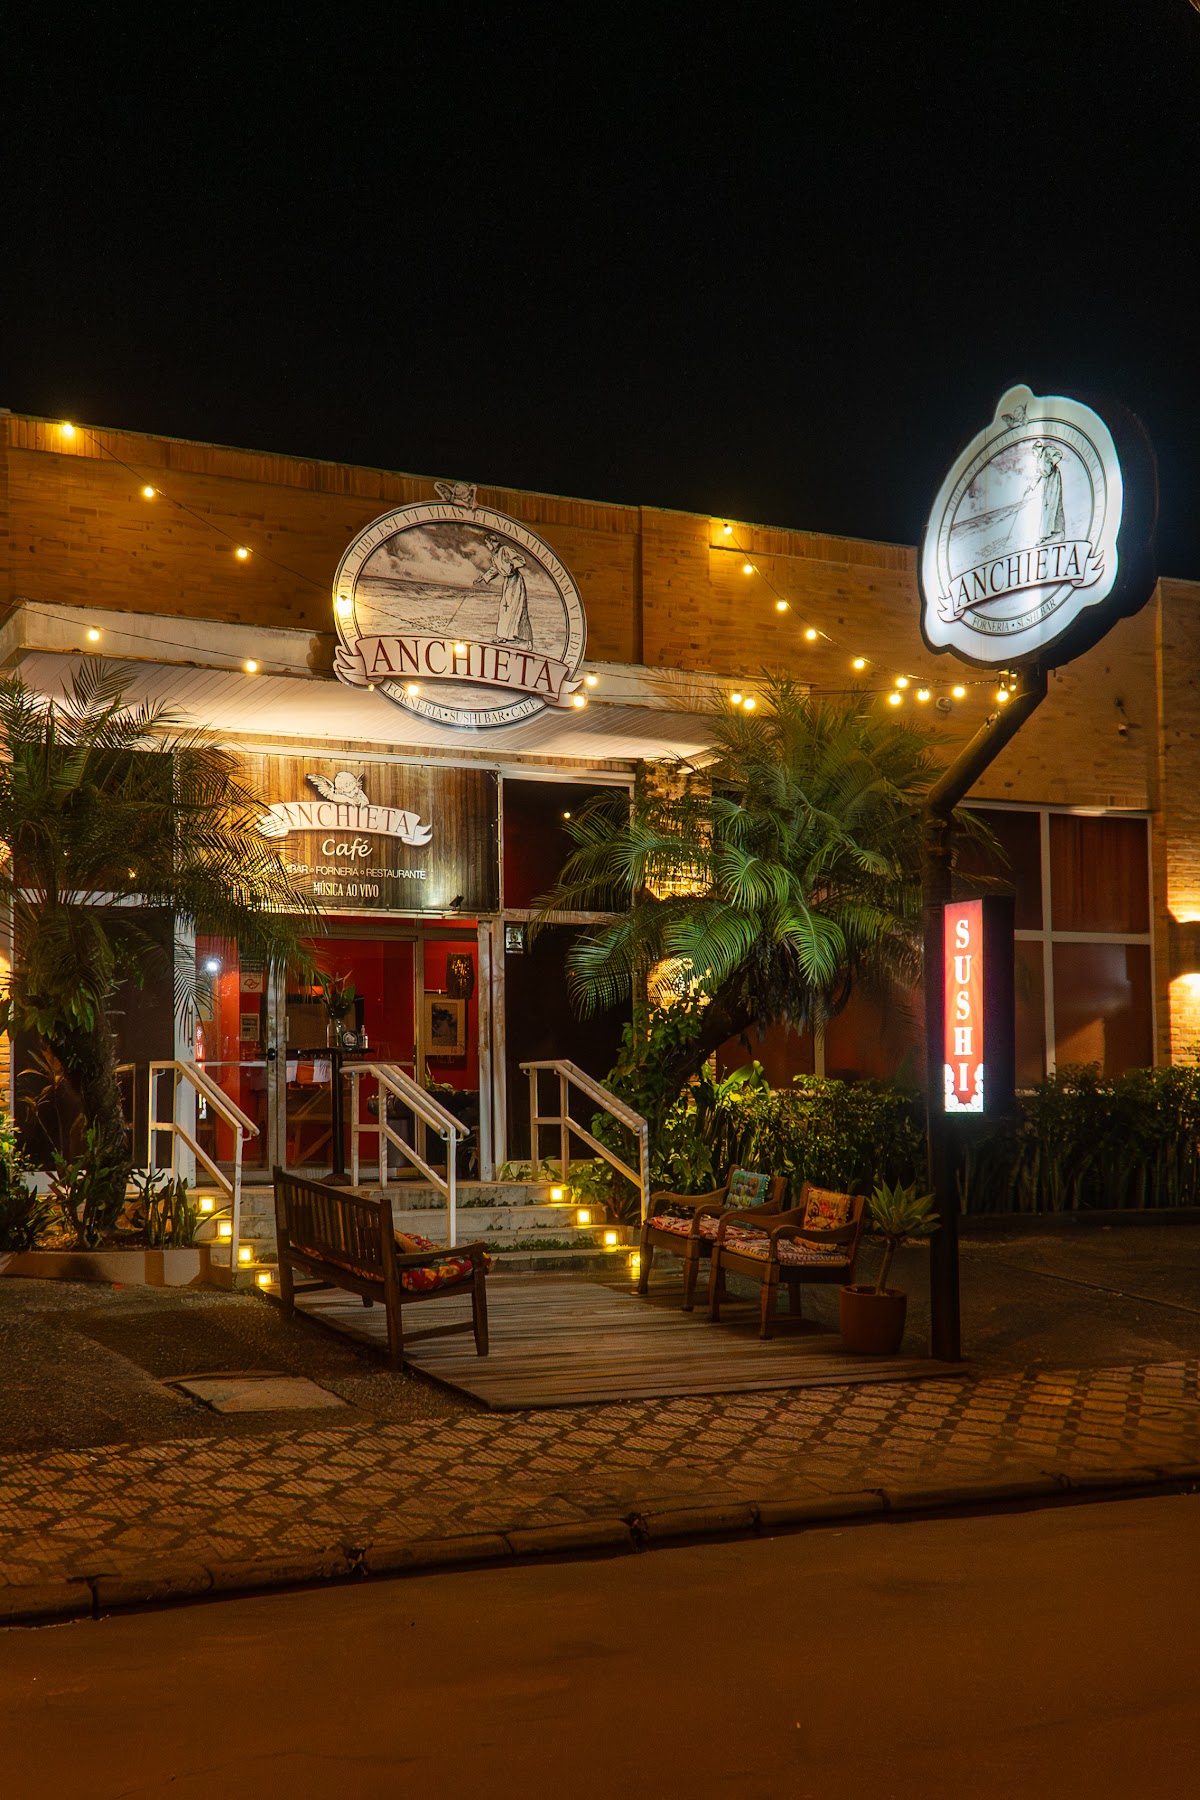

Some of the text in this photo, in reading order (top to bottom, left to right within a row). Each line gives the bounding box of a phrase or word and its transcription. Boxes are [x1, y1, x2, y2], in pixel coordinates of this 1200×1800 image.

[341, 568, 356, 640] EDDVM
[351, 534, 375, 560] TIBI
[376, 515, 399, 538] EST
[428, 505, 464, 519] VIVAS
[473, 510, 488, 522] ET
[493, 515, 521, 539] NON
[526, 534, 573, 596] VIVENDVM
[957, 543, 1081, 608] ANCHIETA
[972, 616, 1010, 632] FORNERIA
[1040, 598, 1057, 617] BAR
[371, 638, 556, 694] ANCHIETA
[386, 682, 443, 719] FORNERIA
[450, 711, 482, 725] SUSHI
[485, 711, 507, 724] BAR
[281, 803, 411, 835] ANCHIETA
[322, 838, 373, 861] Café
[289, 863, 309, 874] BAR
[315, 866, 359, 877] FORNERIA
[366, 868, 427, 880] RESTAURANTE
[313, 880, 379, 898] MÚSICA AO VIVO
[953, 919, 974, 1092] SUSHI
